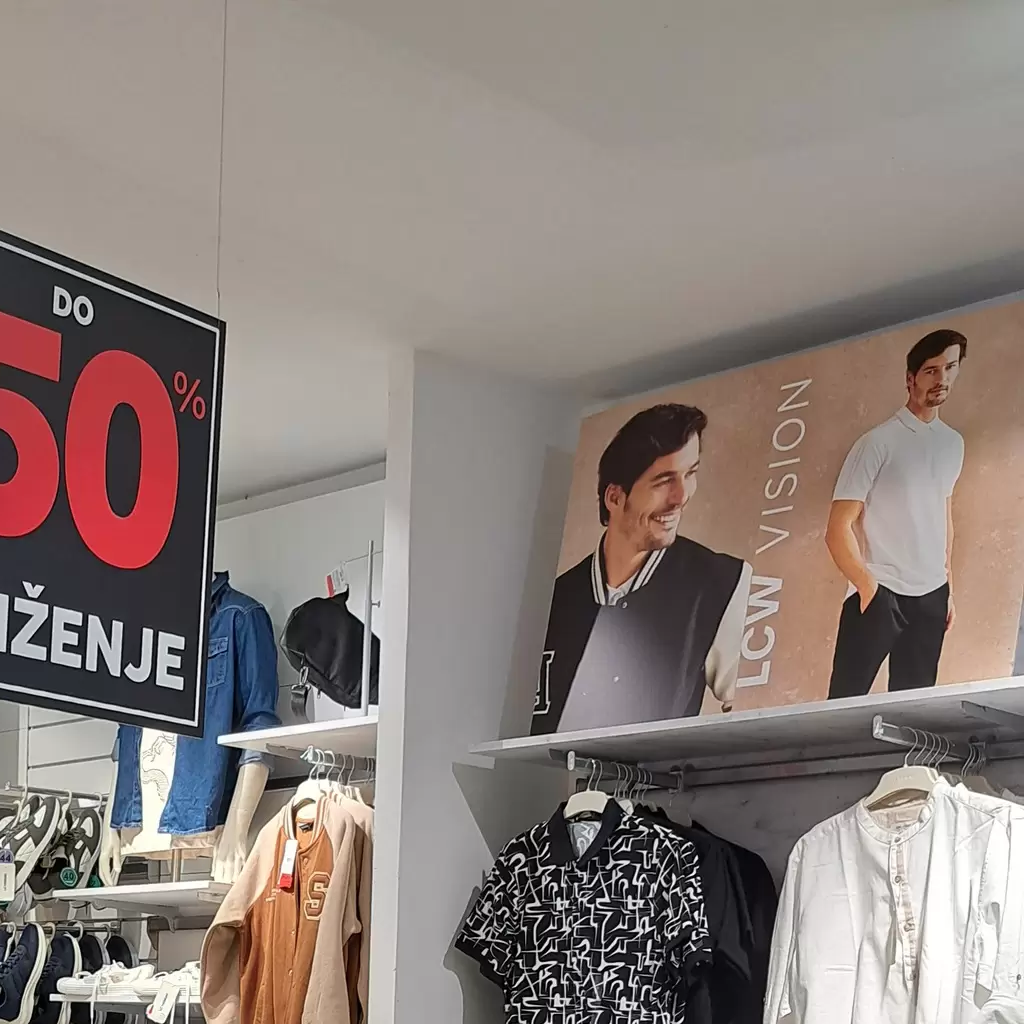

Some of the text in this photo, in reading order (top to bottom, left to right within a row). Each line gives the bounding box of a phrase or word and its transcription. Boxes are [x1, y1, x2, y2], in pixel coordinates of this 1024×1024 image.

[52, 285, 95, 326] DO
[736, 377, 813, 689] LCW VISION
[0, 854, 11, 862] 44
[63, 872, 74, 881] 40
